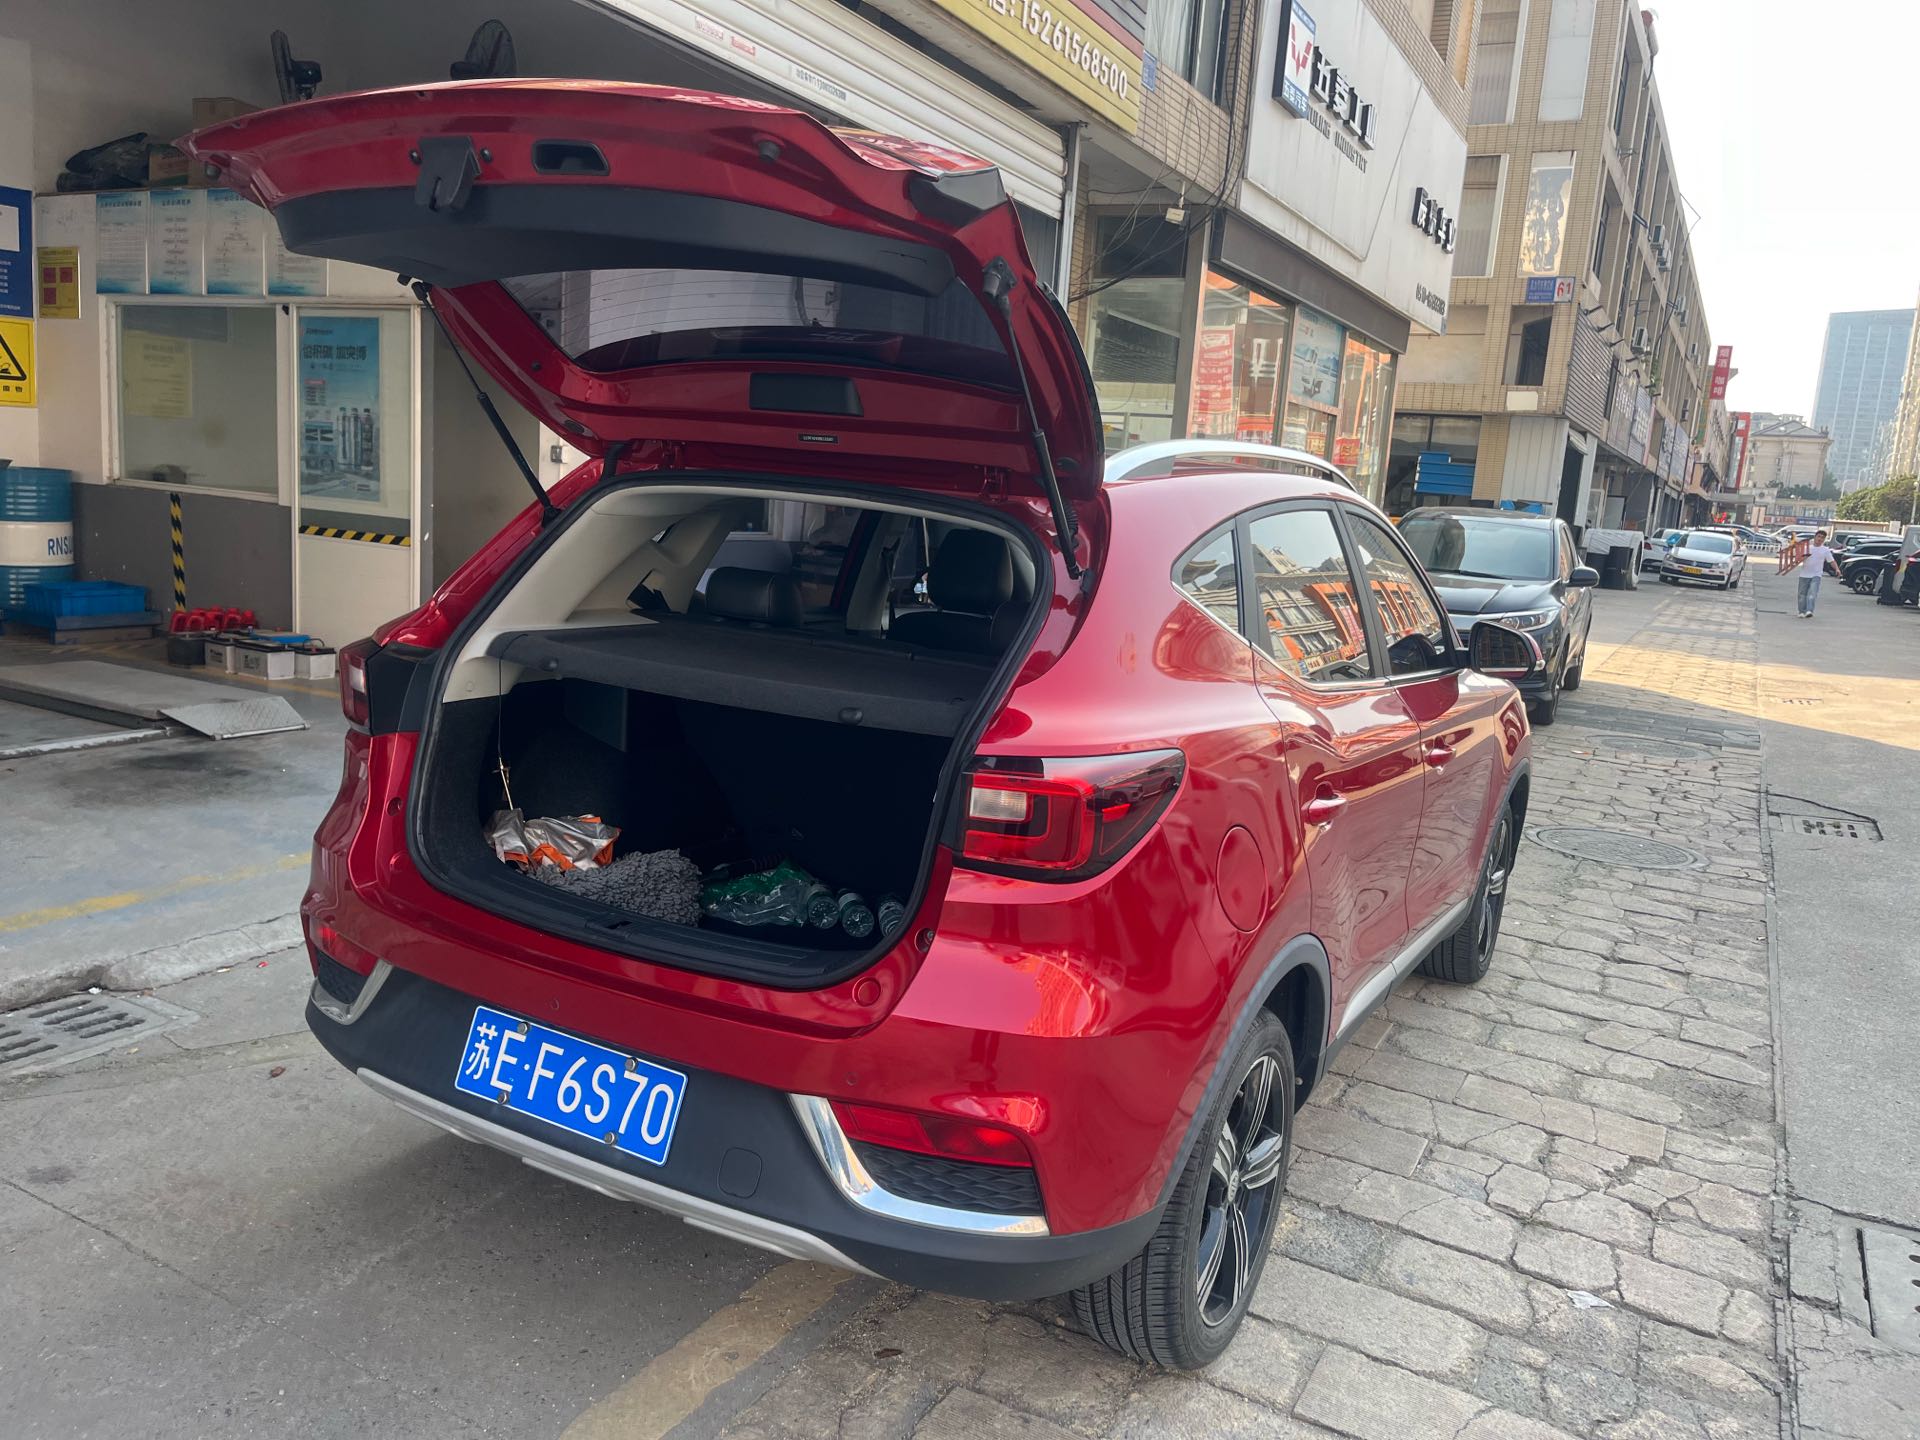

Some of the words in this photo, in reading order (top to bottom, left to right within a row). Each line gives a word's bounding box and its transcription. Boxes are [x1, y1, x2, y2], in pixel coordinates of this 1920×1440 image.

[1283, 82, 1308, 113] 五菱汽车
[1334, 130, 1368, 174] INDUSTRY
[1557, 281, 1571, 297] 61
[465, 1022, 675, 1146] 苏E·F6S70
